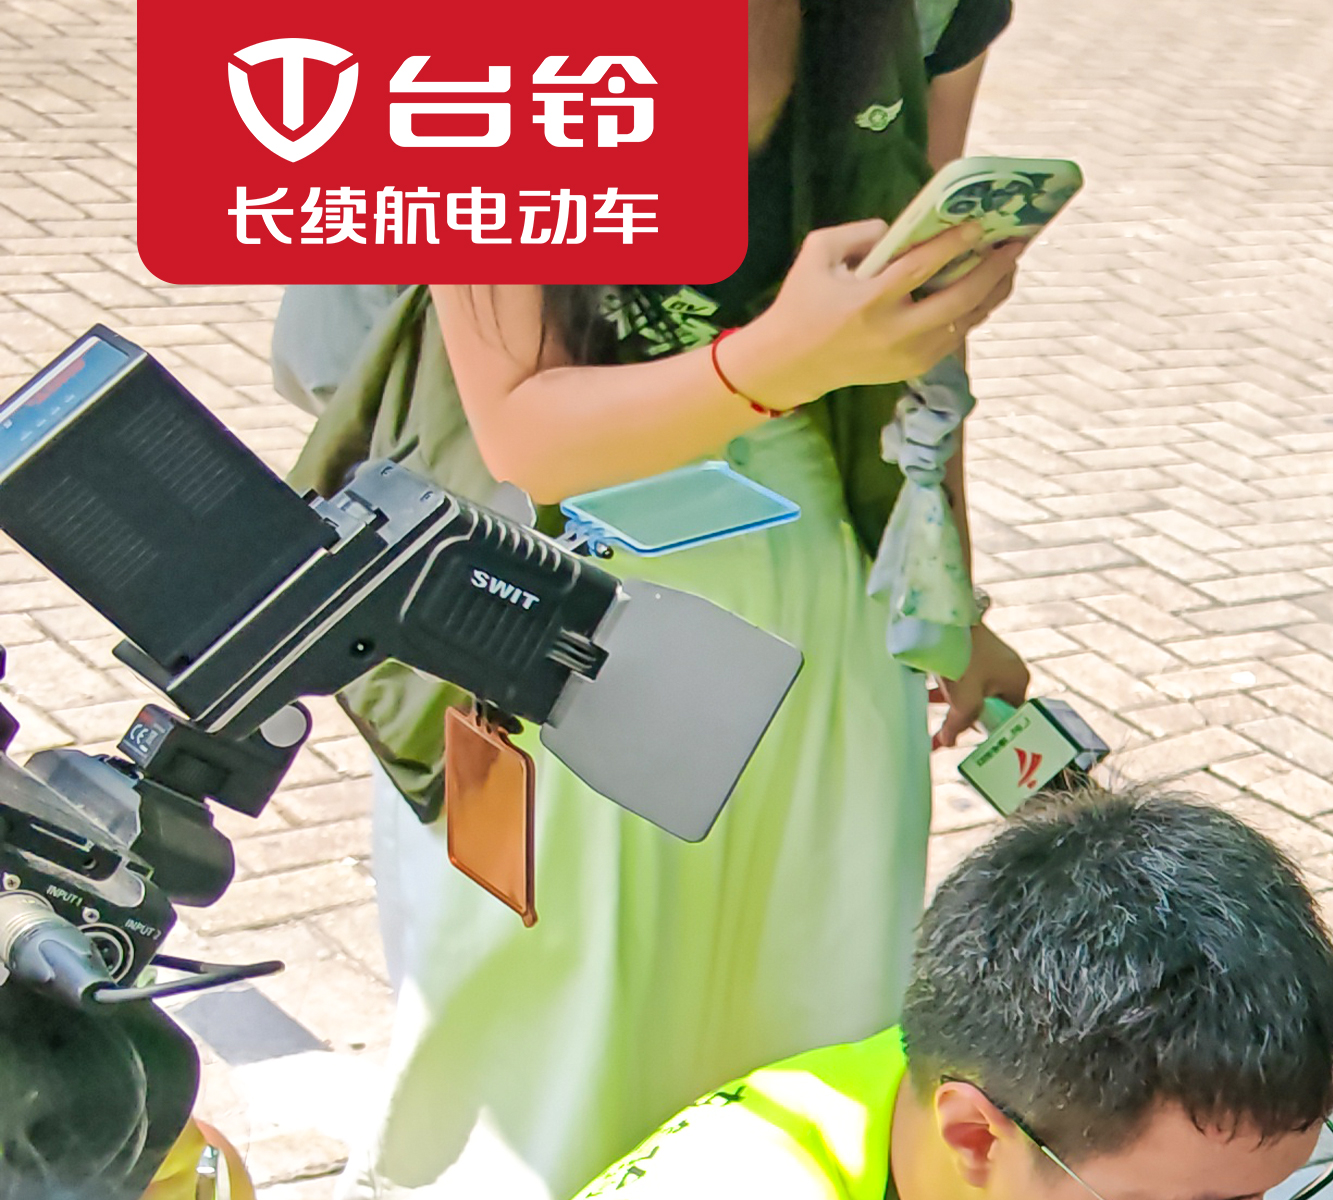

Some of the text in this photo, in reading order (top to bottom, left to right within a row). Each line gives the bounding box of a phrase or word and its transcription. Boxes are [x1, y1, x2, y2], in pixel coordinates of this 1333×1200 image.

[470, 569, 540, 610] SWIT
[46, 885, 79, 903] INPUT
[124, 918, 155, 937] INPUT
